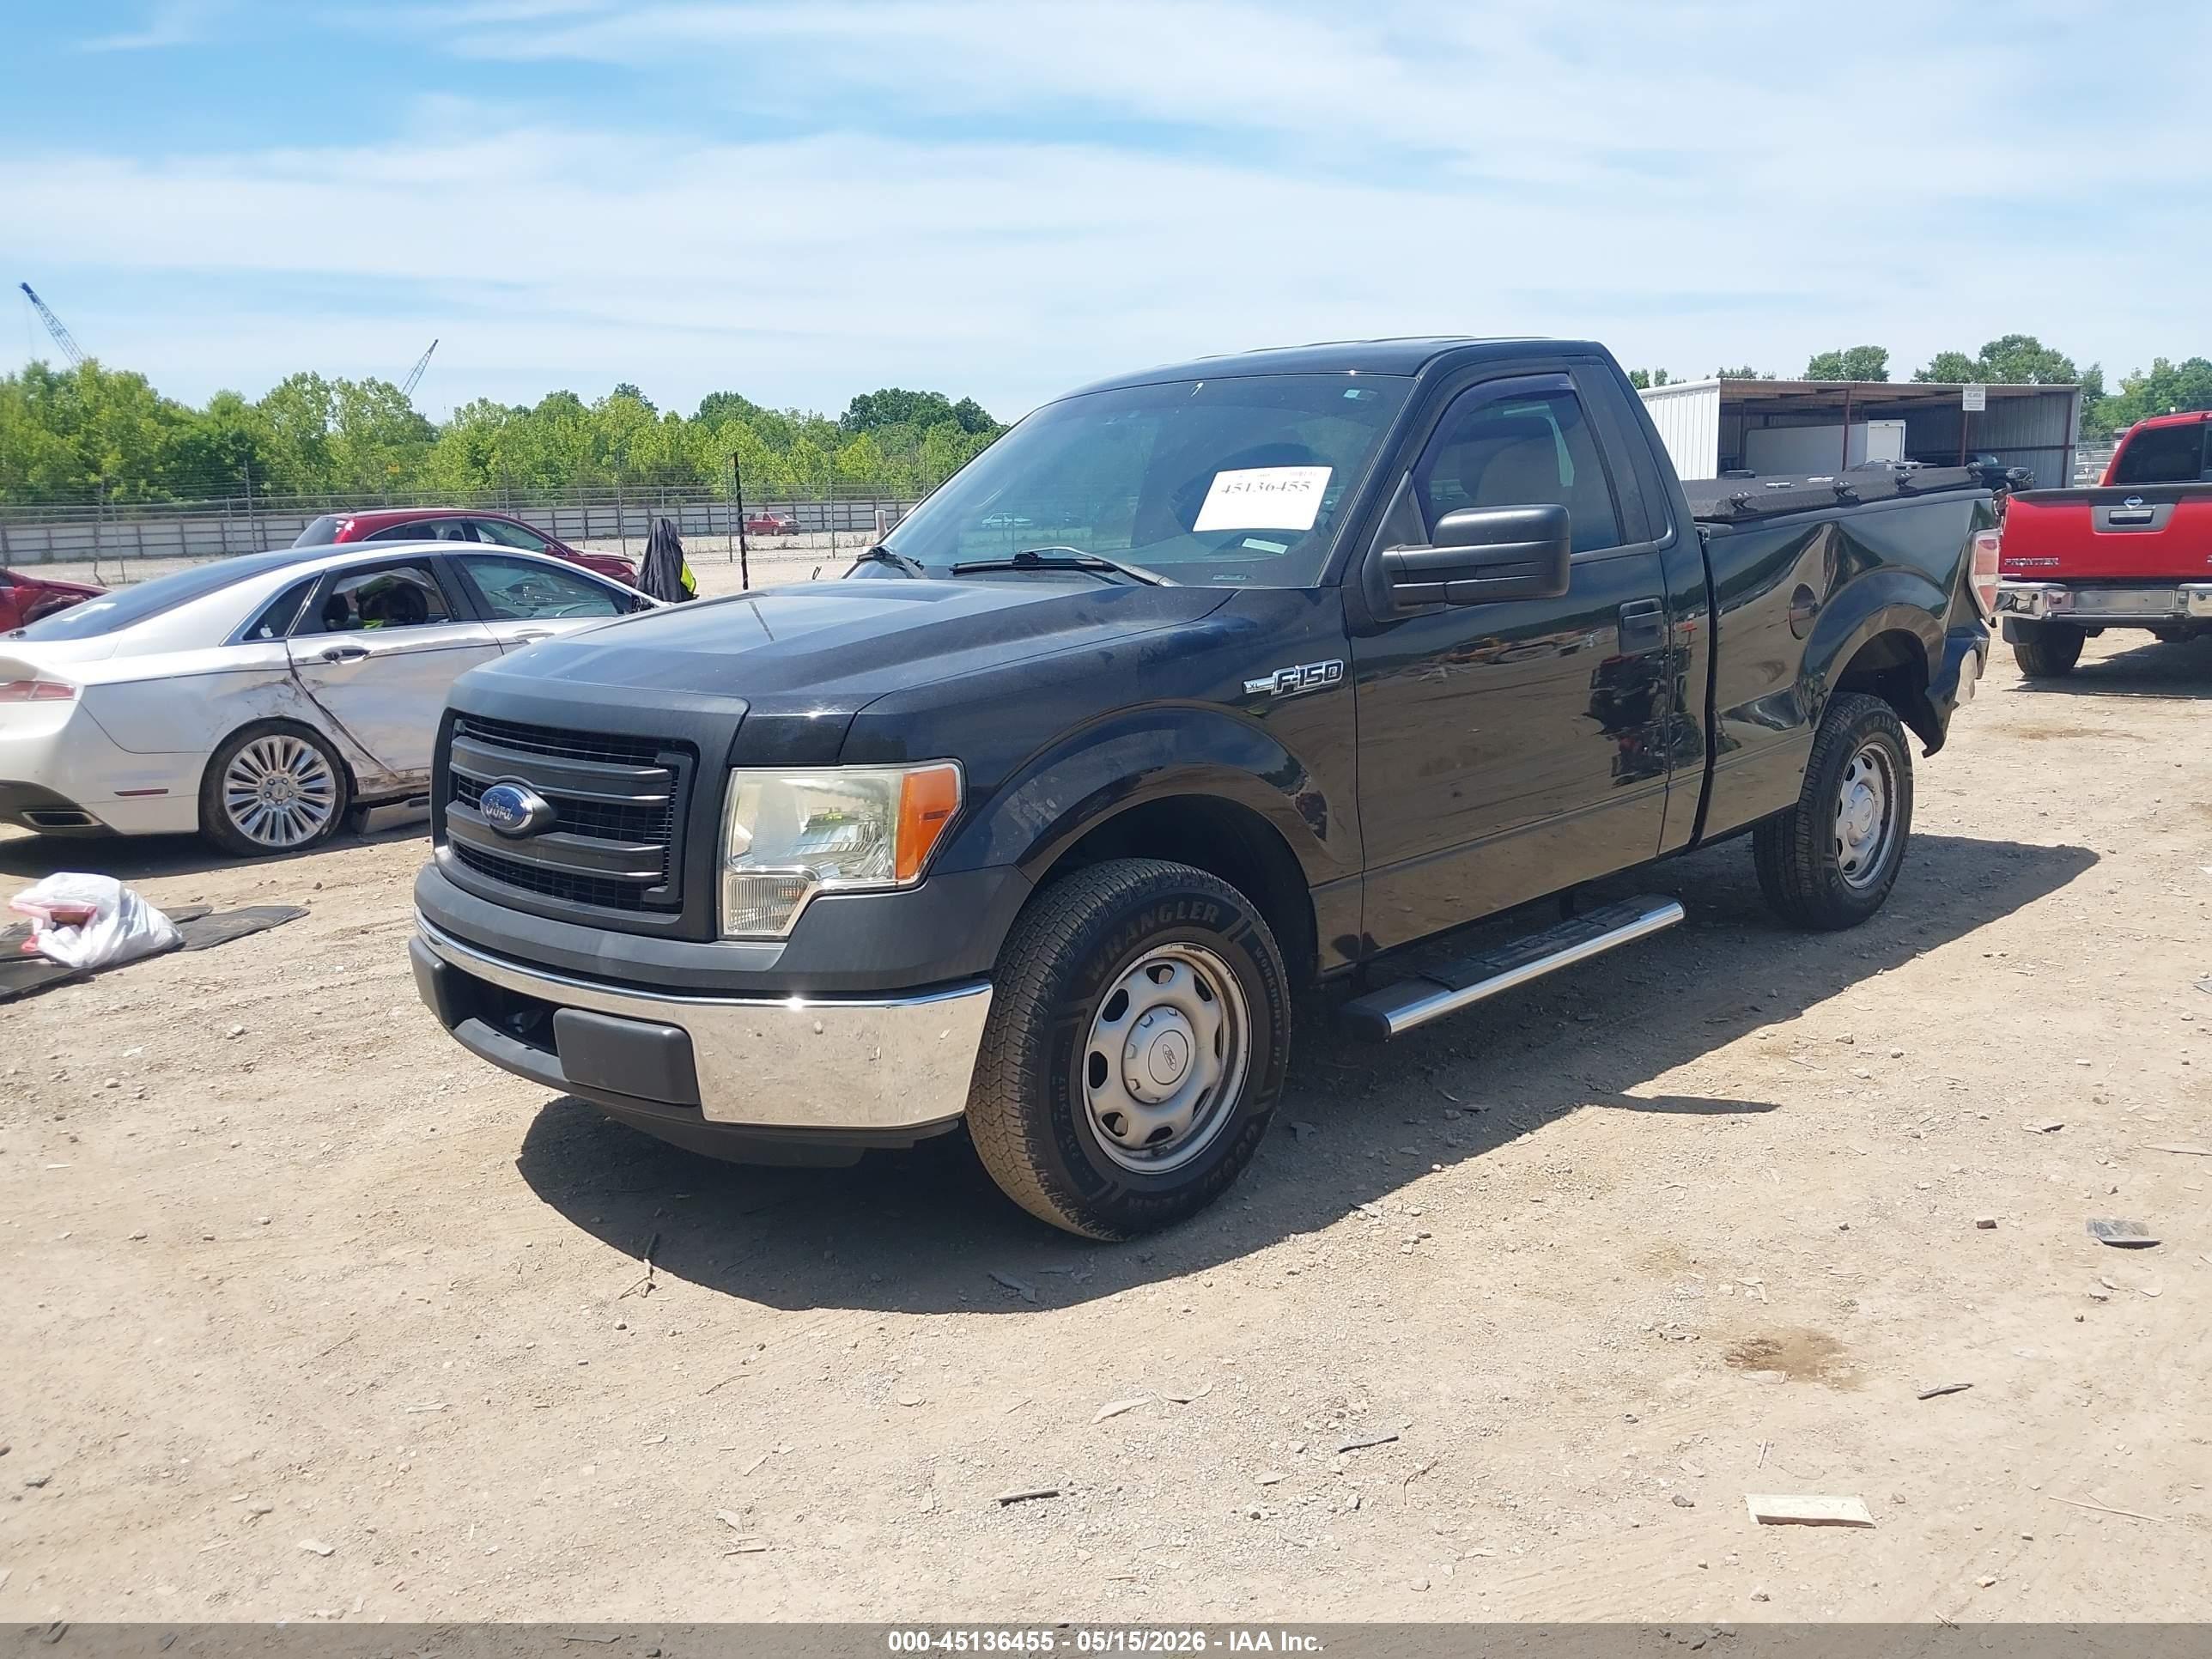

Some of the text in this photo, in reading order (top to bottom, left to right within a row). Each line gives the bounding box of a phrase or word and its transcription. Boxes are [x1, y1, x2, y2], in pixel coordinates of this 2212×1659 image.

[2004, 556, 2060, 567] FRONTIER
[485, 795, 515, 821] Ford
[1084, 900, 1221, 983] WRANGLER
